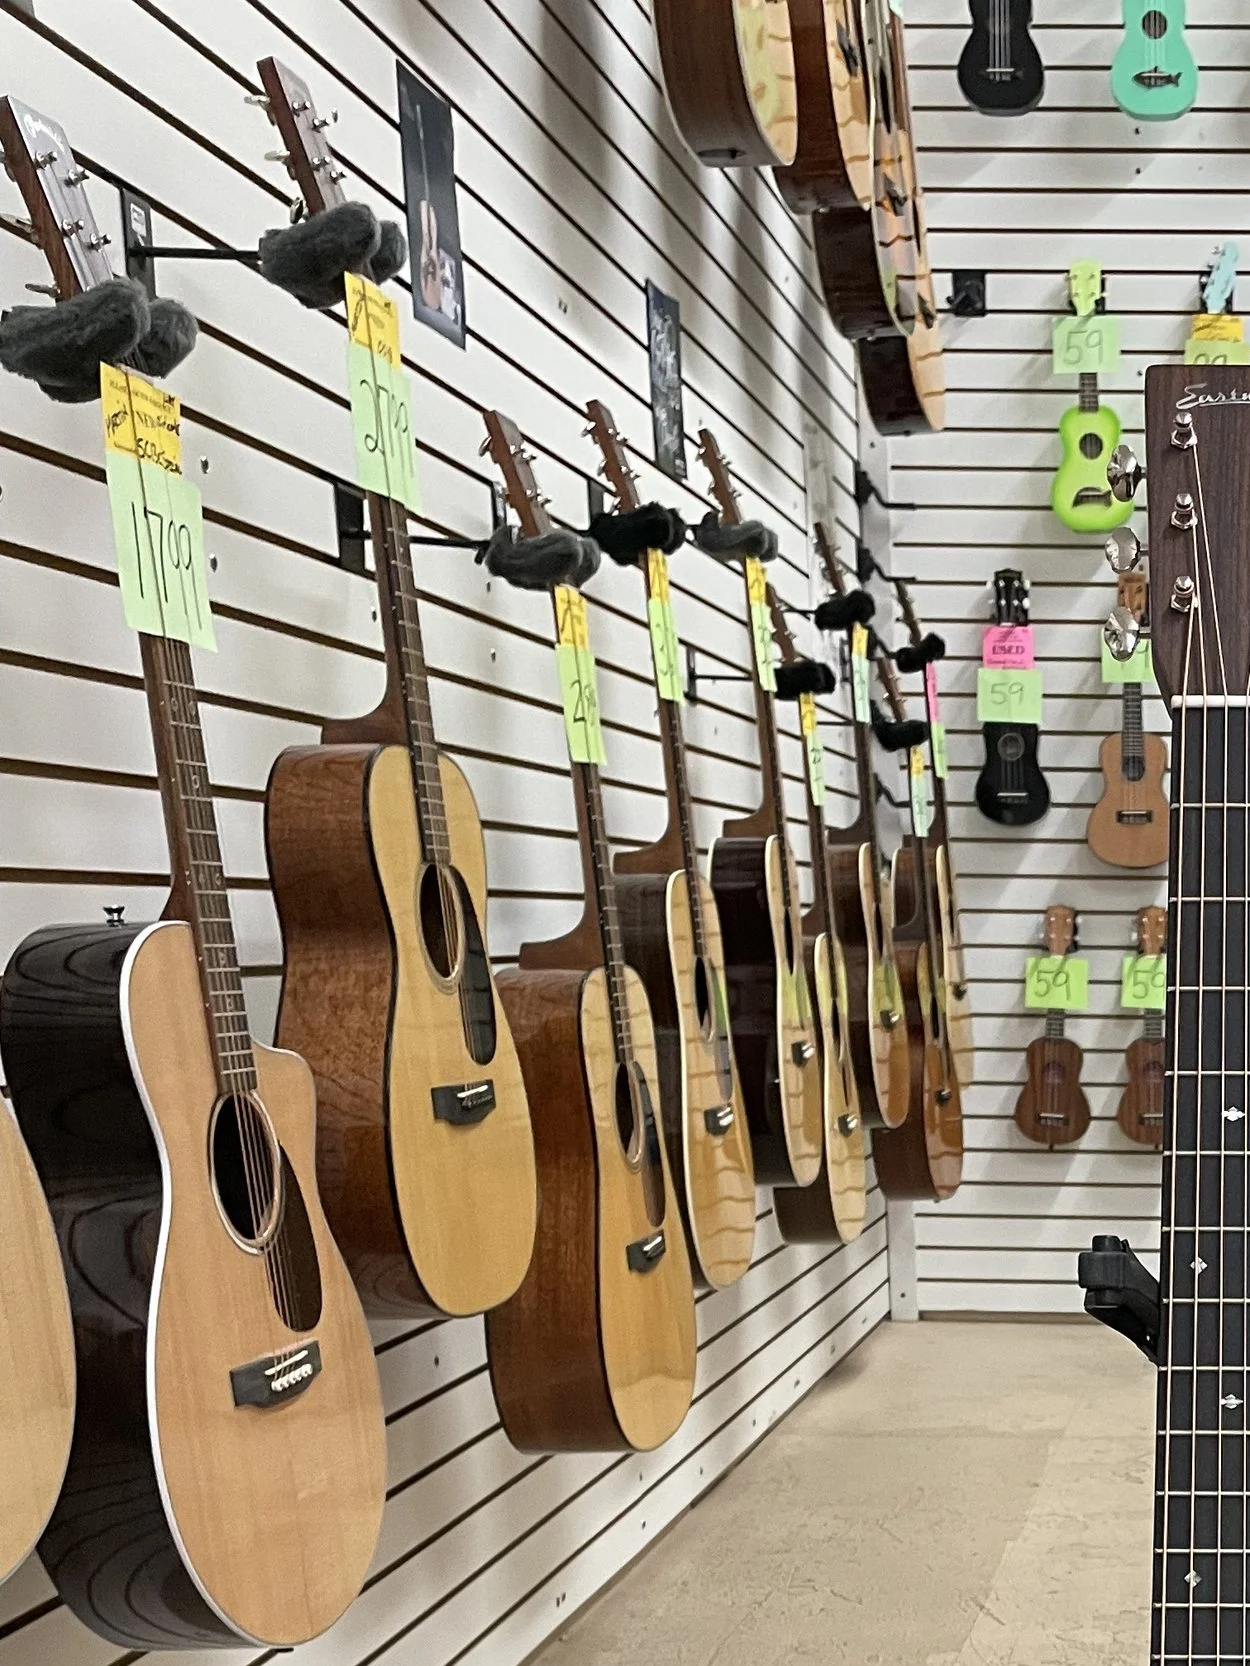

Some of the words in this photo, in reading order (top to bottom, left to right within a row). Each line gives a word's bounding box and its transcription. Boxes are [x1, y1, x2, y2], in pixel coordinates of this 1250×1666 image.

[1063, 329, 1103, 366] 59
[131, 501, 204, 632] 1799
[990, 682, 1025, 705] 59
[1034, 970, 1072, 1001] 59
